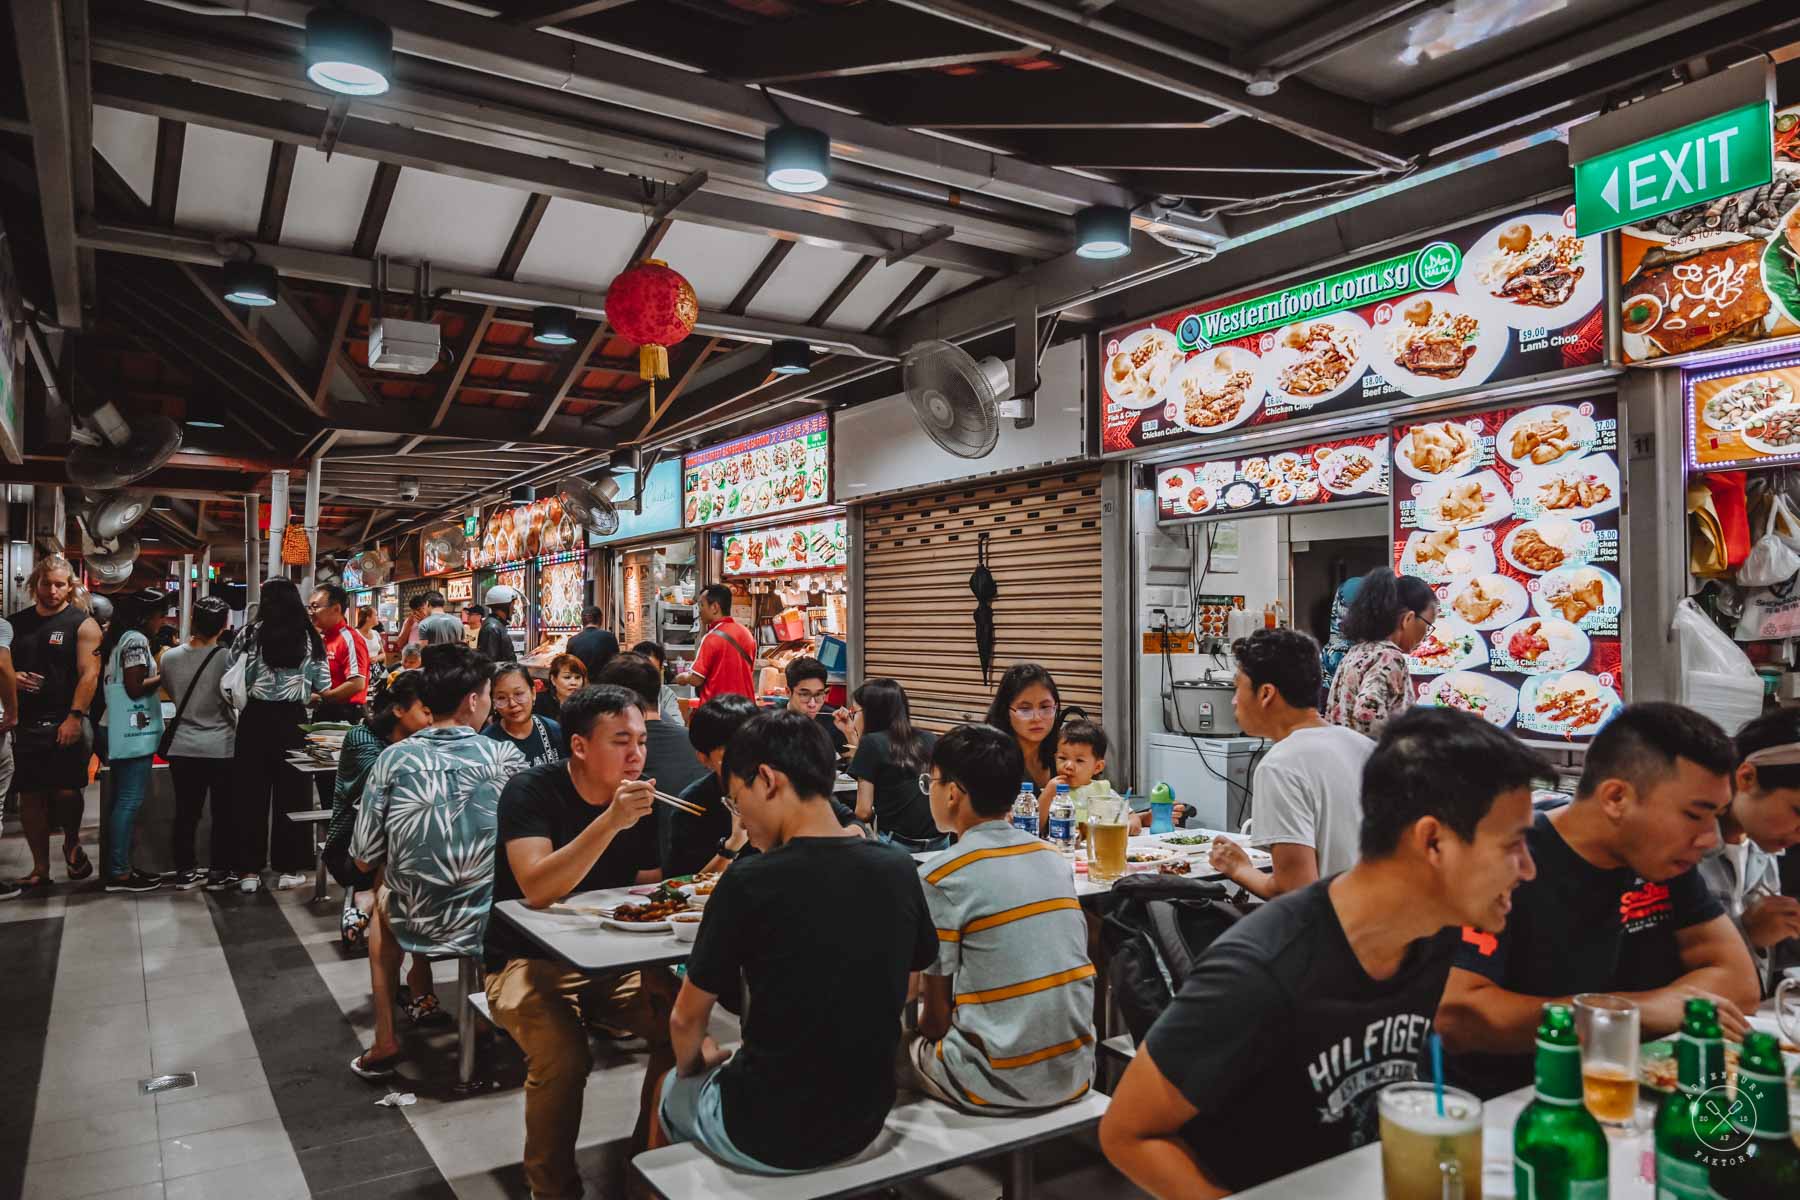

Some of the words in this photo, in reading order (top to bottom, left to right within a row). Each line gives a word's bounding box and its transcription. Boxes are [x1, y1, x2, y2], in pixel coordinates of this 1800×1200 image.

[1628, 126, 1739, 210] EXIT
[1424, 264, 1451, 278] HALAL
[1203, 264, 1411, 337] Westernfood.com.sg
[1376, 308, 1390, 321] 04
[1523, 326, 1545, 340] $9.00
[1262, 336, 1274, 350] 03
[1520, 339, 1548, 353] Lamb
[1550, 334, 1579, 347] Chop
[1365, 376, 1383, 386] $8.00
[1362, 387, 1381, 398] Beef
[1265, 404, 1293, 416] Chicken
[1294, 402, 1314, 411] Chop
[1595, 420, 1615, 430] $7.00
[1142, 430, 1165, 440] Chicken
[1601, 430, 1616, 438] Pcs
[1582, 523, 1592, 531] 12
[1597, 530, 1616, 540] $5.00
[1600, 548, 1618, 556] Rice
[1597, 606, 1617, 615] $4.00
[1600, 677, 1610, 685] 17
